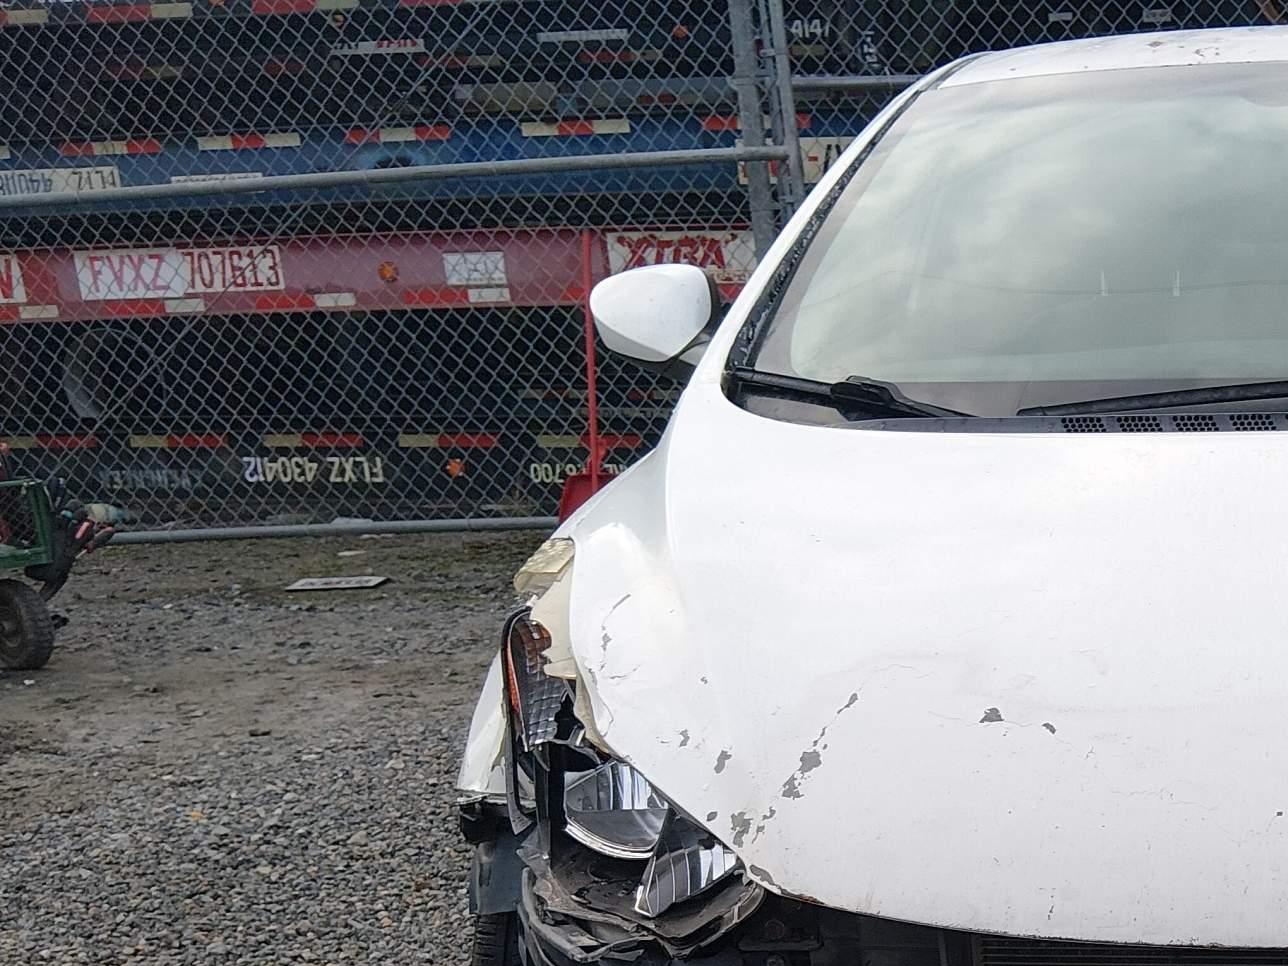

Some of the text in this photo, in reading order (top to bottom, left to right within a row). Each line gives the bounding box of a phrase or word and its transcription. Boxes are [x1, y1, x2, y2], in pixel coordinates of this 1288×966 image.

[182, 248, 281, 289] 707613
[617, 233, 726, 269] XTRA
[242, 456, 385, 483] FLXZ 430412
